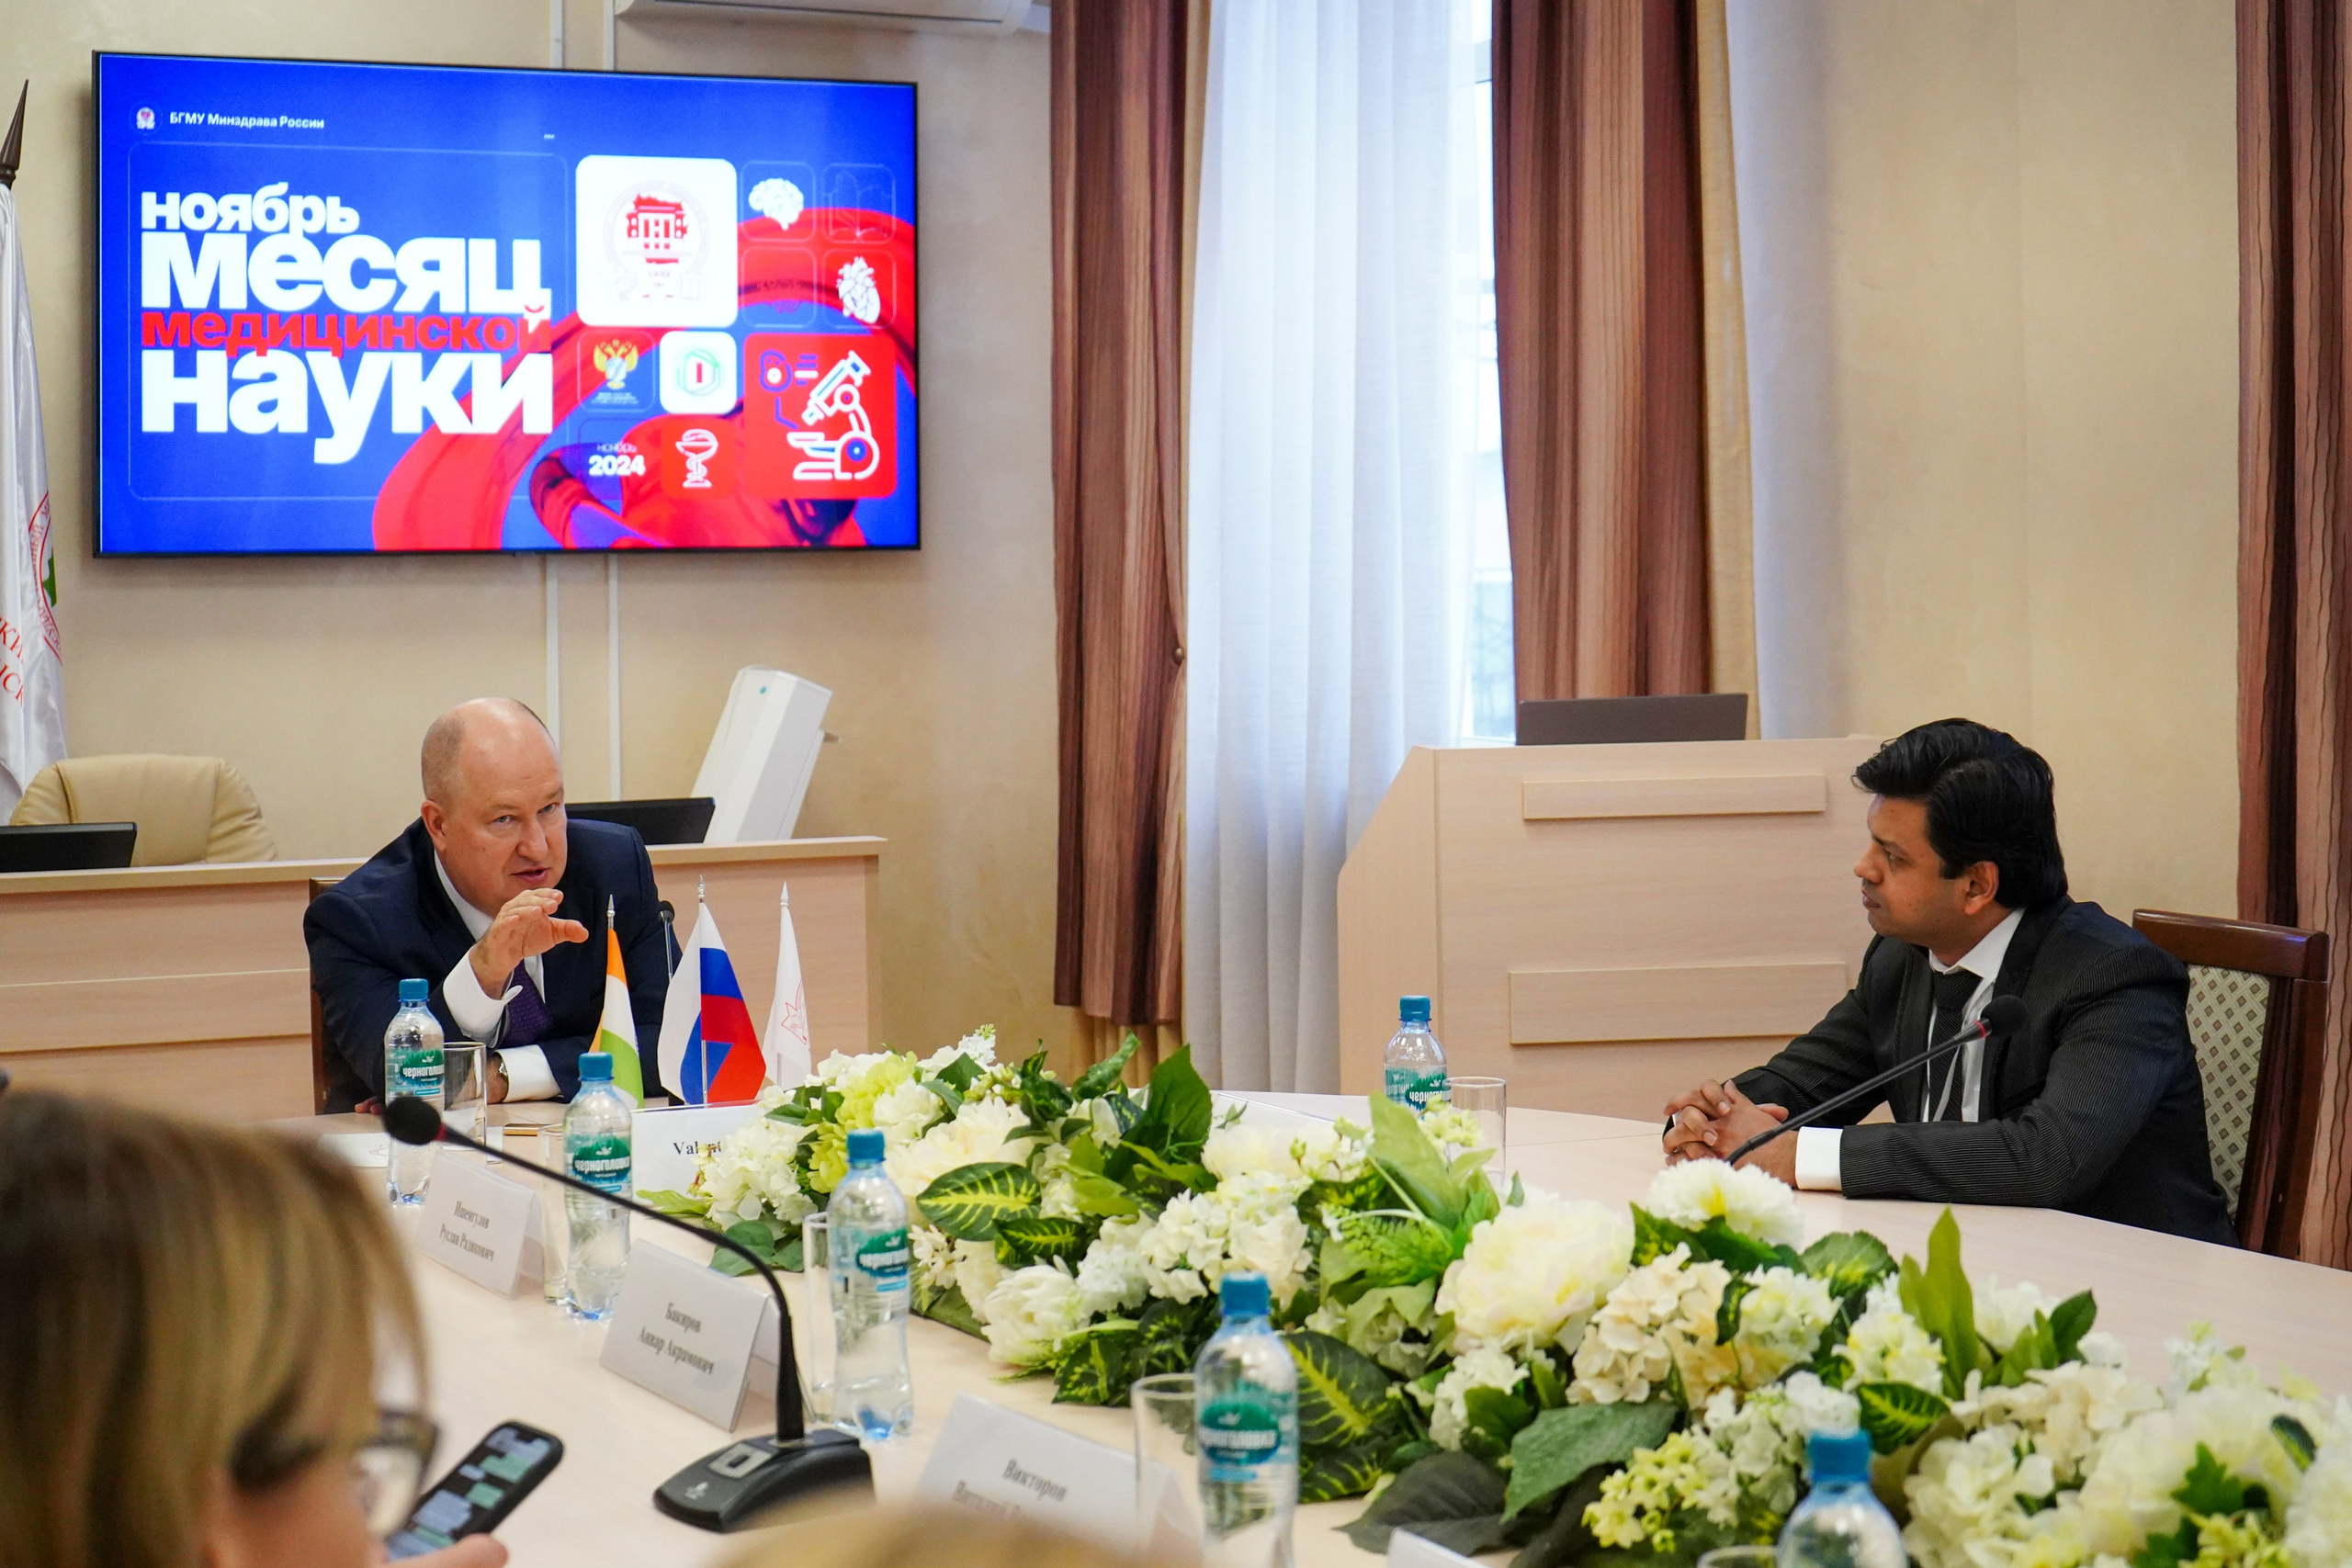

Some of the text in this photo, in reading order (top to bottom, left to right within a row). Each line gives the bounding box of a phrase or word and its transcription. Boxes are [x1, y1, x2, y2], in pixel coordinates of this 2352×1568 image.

[169, 111, 325, 130] БГМУ Минздрава России
[141, 350, 553, 465] науки
[588, 454, 647, 477] 2024
